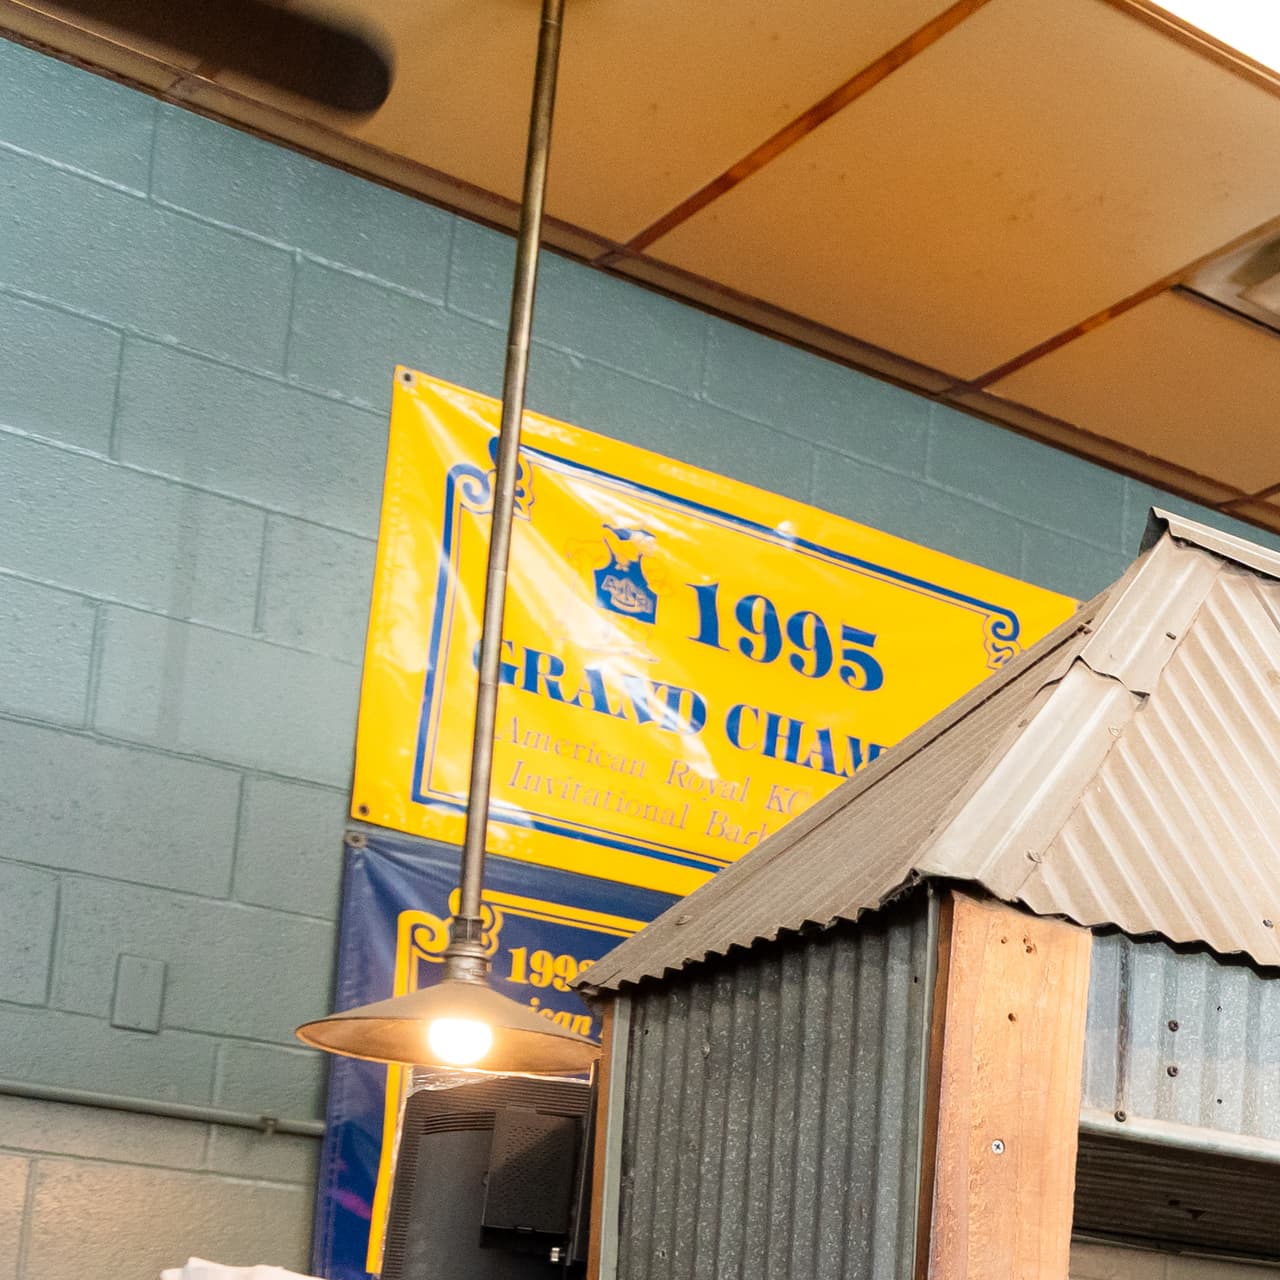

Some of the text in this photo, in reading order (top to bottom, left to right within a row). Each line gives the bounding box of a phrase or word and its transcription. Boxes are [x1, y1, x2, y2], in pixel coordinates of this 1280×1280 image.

[686, 582, 885, 693] 1995
[471, 637, 892, 783] GRAND CHAM
[492, 714, 812, 822] American Royal KC
[508, 759, 691, 834] Invitational
